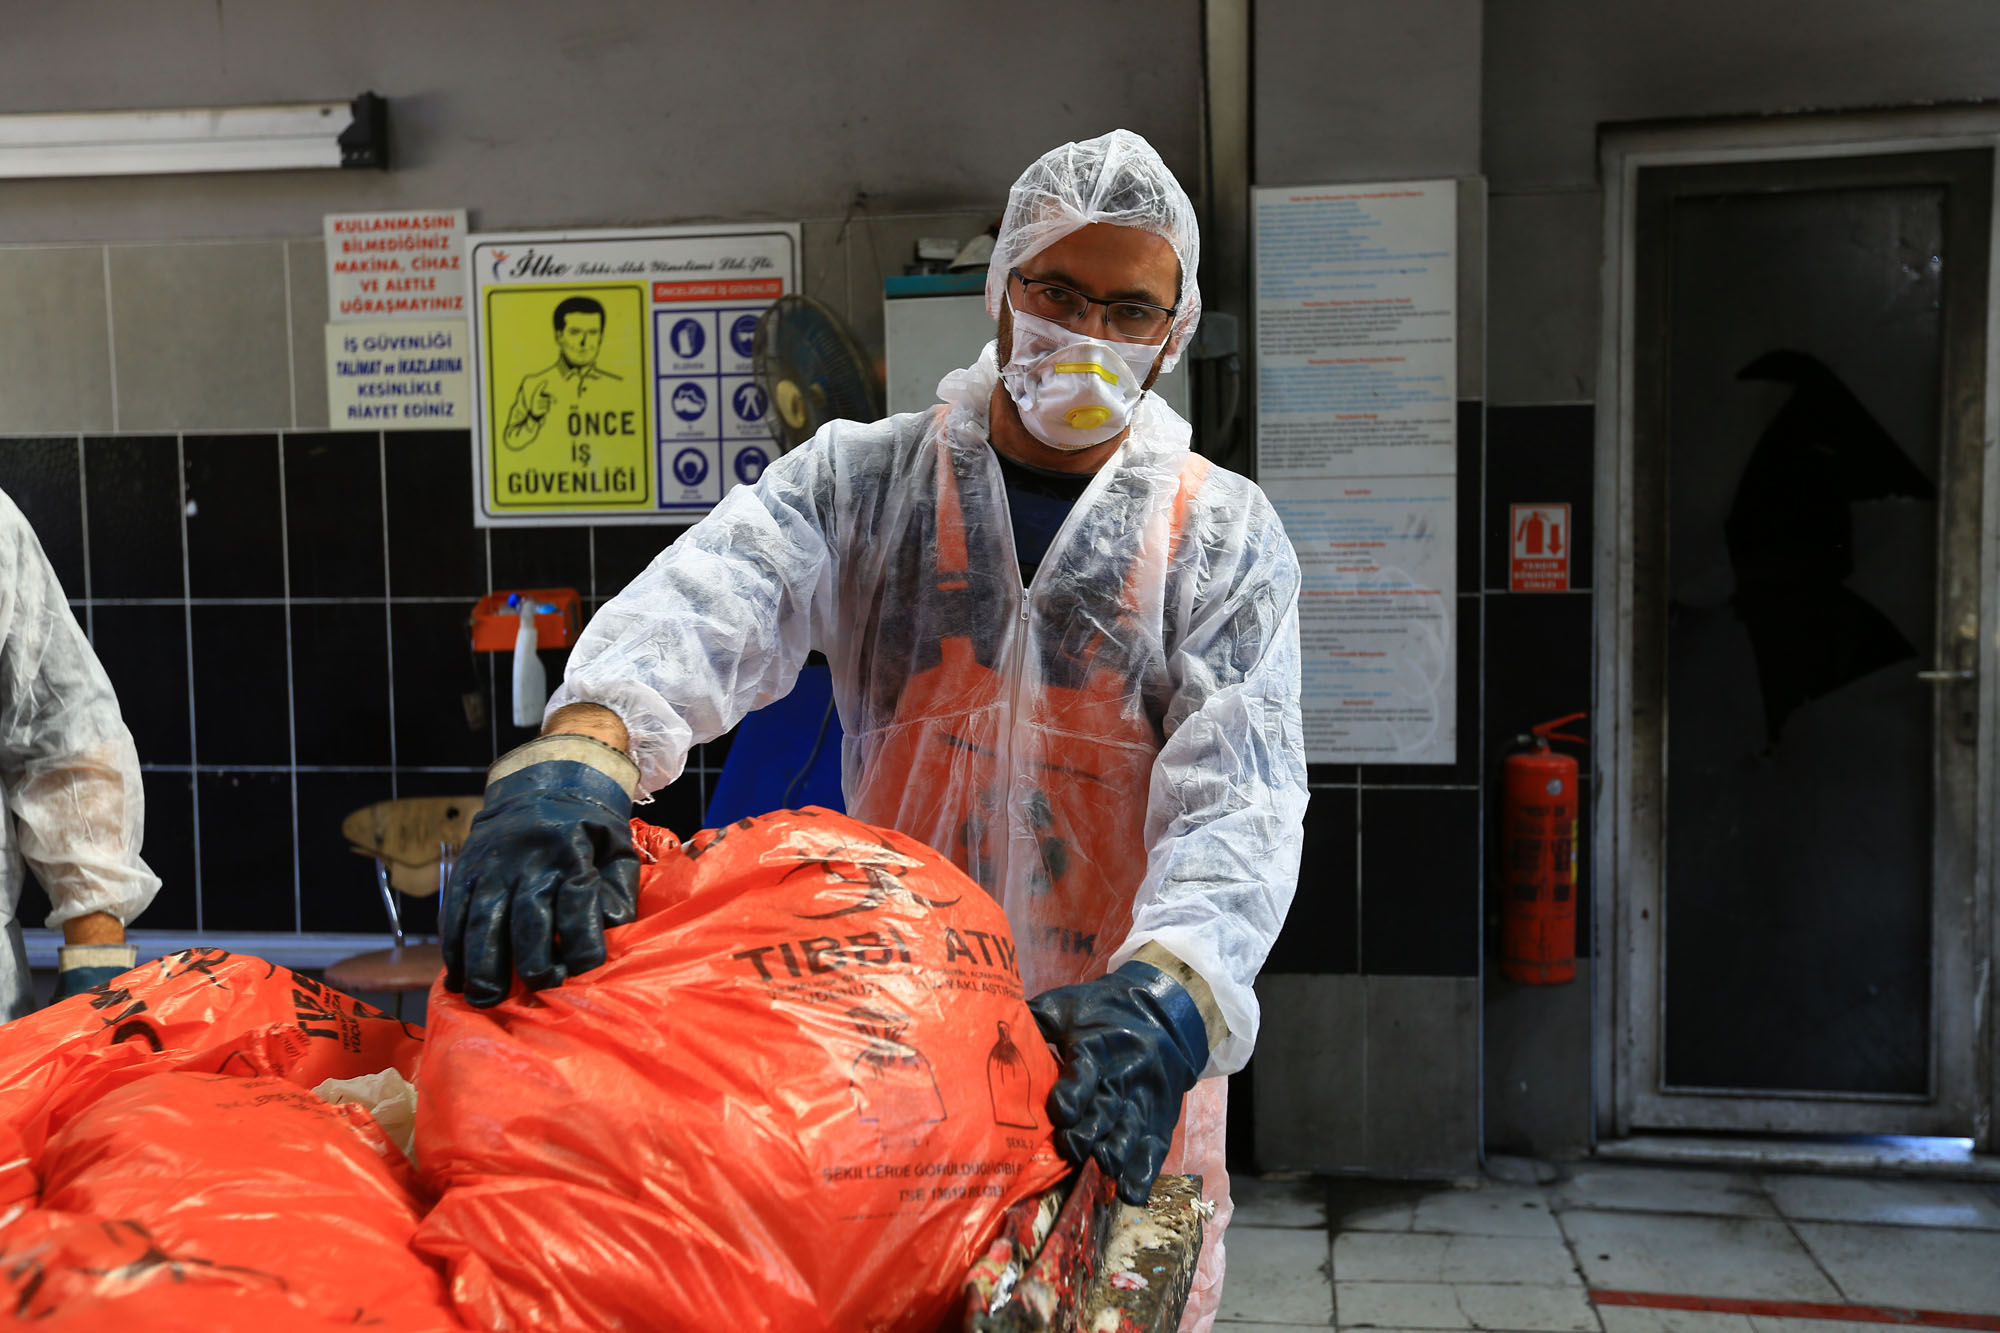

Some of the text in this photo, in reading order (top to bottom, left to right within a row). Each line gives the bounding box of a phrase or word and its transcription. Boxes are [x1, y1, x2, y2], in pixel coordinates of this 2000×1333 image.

[334, 216, 455, 233] KULLANMASINI
[342, 236, 451, 253] BİLMEDİĞİNİZ
[411, 254, 460, 271] CİHAZ
[509, 248, 572, 279] İlke
[361, 277, 436, 293] VE ALETLE
[340, 296, 464, 314] UĞRAŞMAYINIZ
[344, 331, 453, 353] İŞ GÜVENLİĞİ
[337, 359, 382, 377] TALİMAT
[398, 357, 463, 375] İKAZLARINA
[357, 381, 442, 398] KESİNLİKLE
[348, 402, 455, 420] RİAYET EDİNİZ
[567, 404, 636, 436] ÖNCE
[571, 443, 592, 468] İŞ
[508, 465, 636, 494] GÜVENLİĞİ
